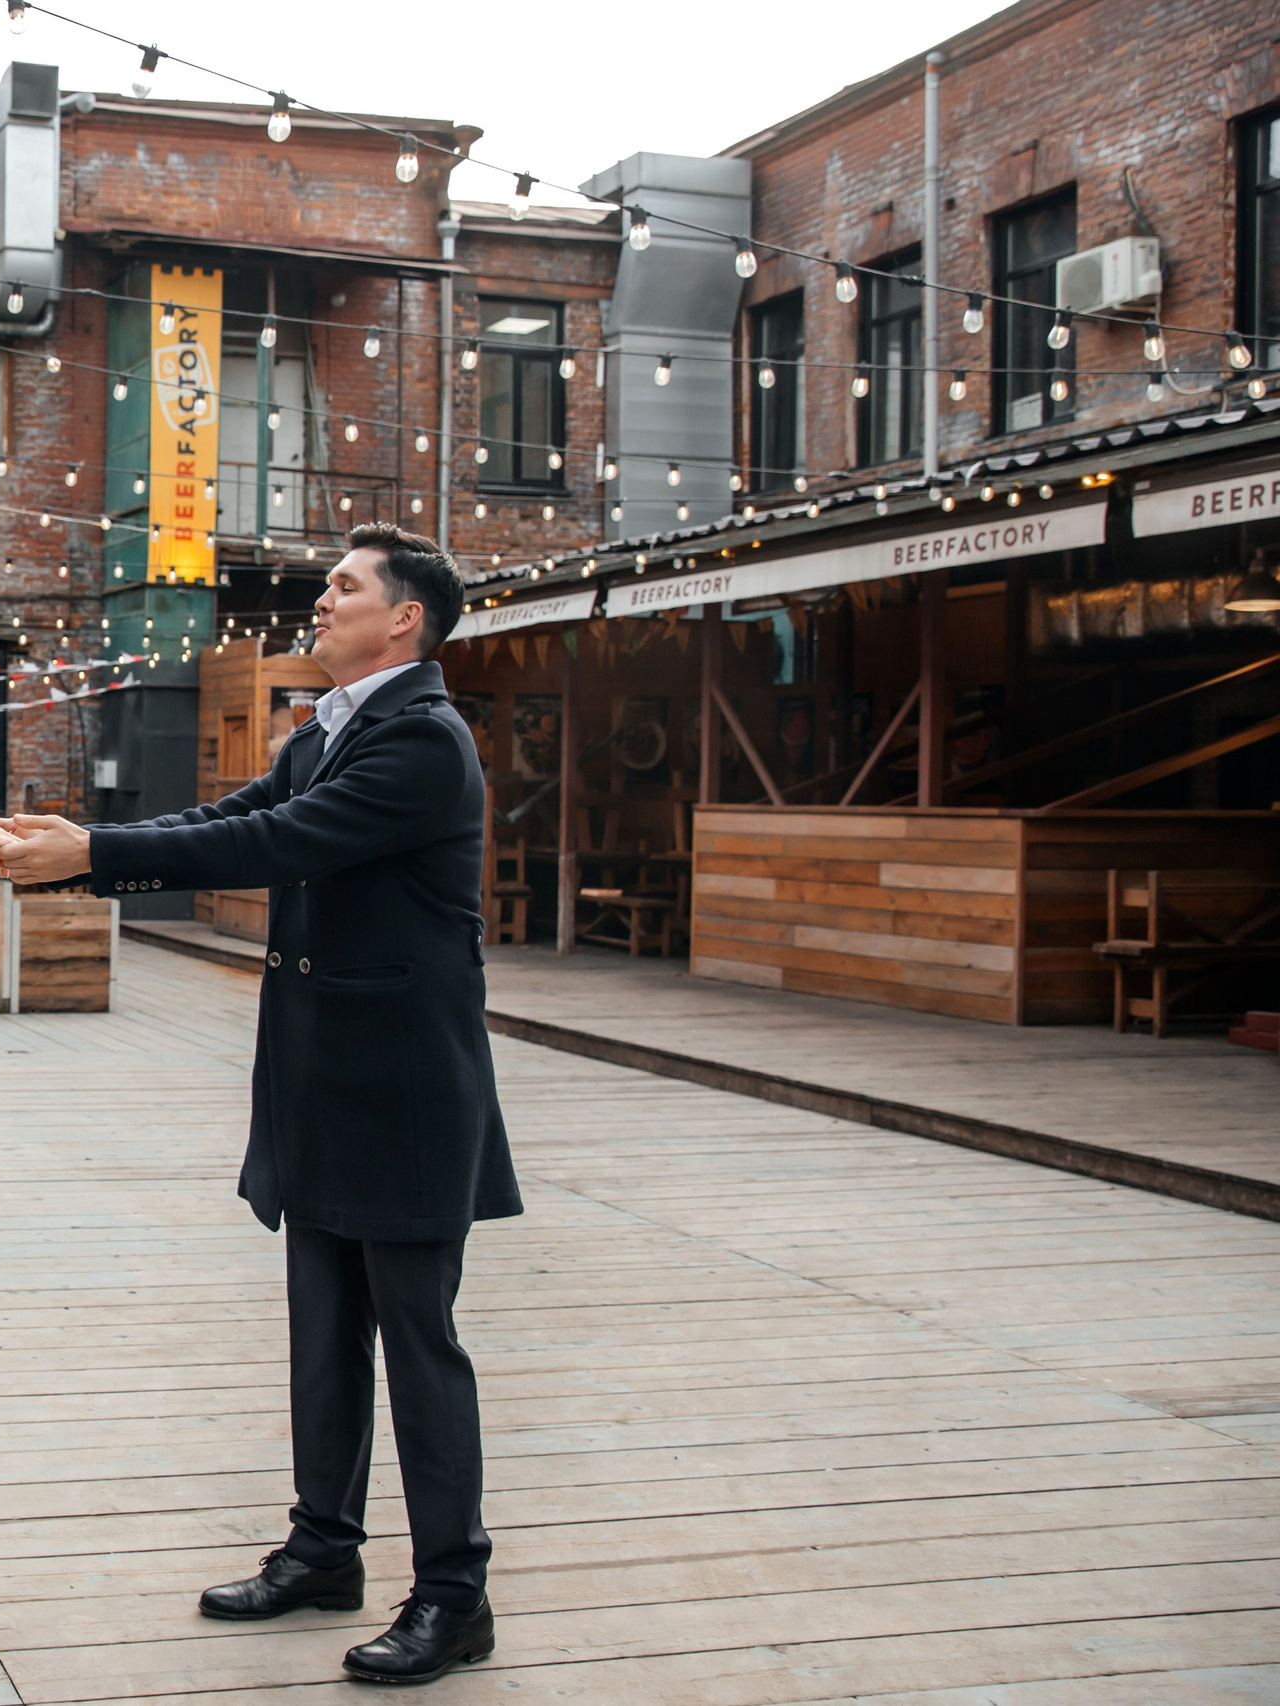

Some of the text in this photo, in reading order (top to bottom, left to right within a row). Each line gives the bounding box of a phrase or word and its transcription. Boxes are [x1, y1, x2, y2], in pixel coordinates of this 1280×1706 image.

[175, 306, 198, 541] BEERFACTORY
[894, 520, 1050, 566] BEERFACTORY
[631, 575, 732, 606] BEERFACTORY
[490, 600, 568, 627] BEERFACTORY
